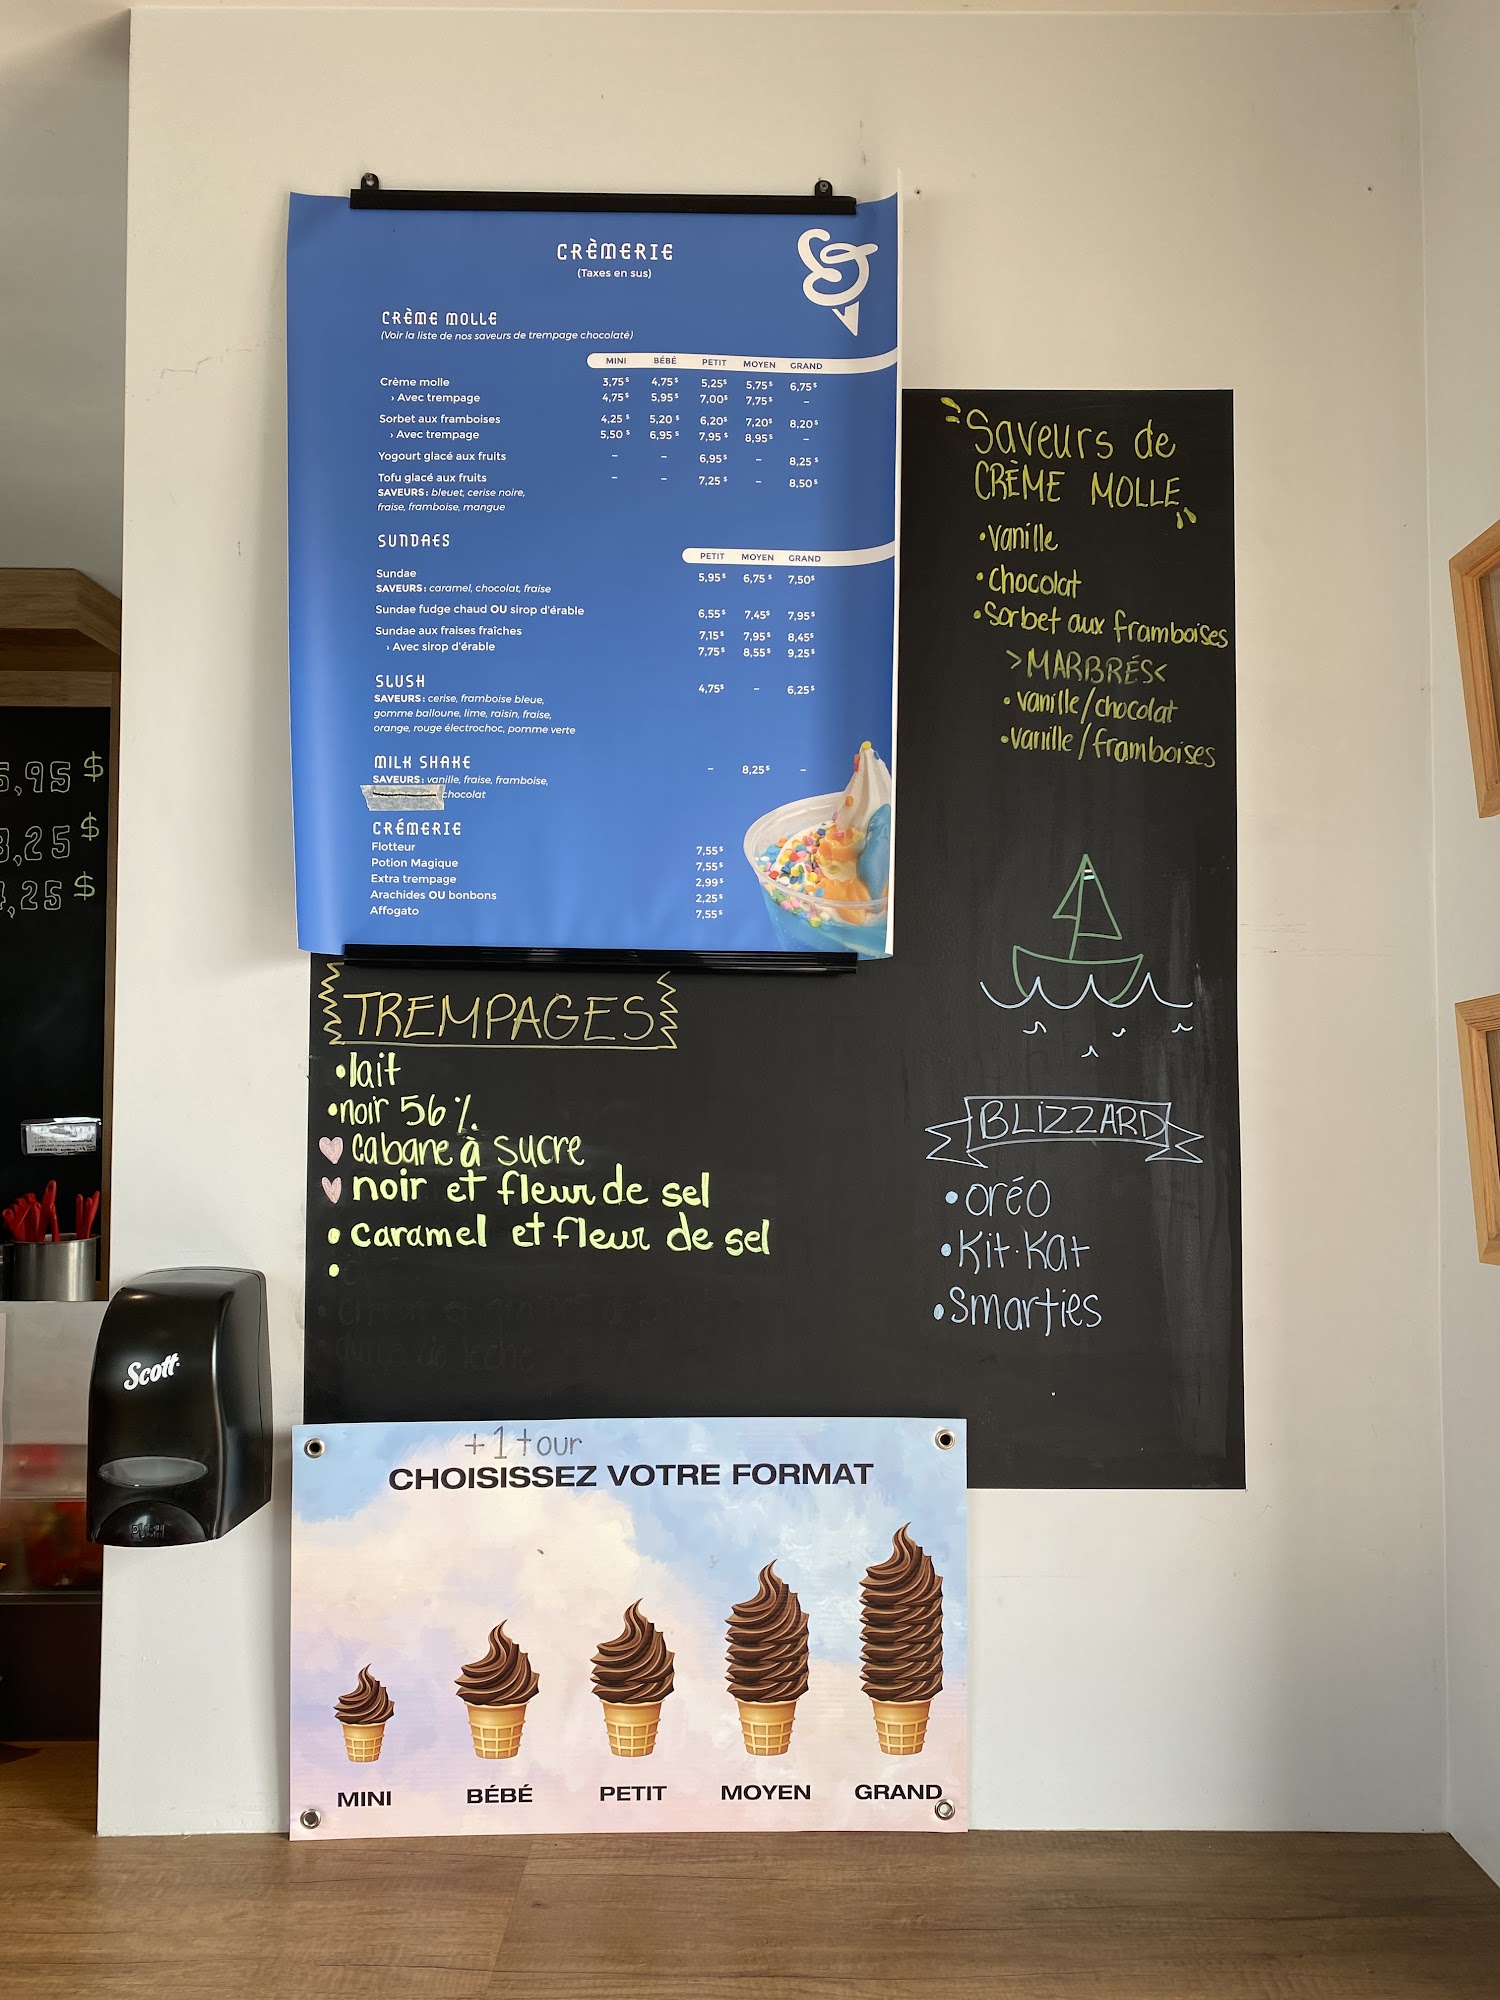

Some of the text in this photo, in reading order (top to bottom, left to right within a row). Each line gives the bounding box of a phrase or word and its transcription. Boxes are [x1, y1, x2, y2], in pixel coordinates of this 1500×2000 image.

[557, 238, 672, 260] CRÈMERIE
[577, 268, 651, 279] (Taxes en sus)
[382, 308, 497, 325] CRÈME MOLLE
[381, 331, 403, 340] (Voir
[405, 331, 415, 339] la
[417, 331, 437, 340] liste
[440, 332, 452, 340] de
[513, 331, 526, 339] de
[529, 332, 578, 341] trempage
[580, 331, 633, 340] chocolaté)
[654, 356, 676, 364] BÉBÉ
[743, 360, 776, 368] MOYEN
[790, 362, 823, 370] GRAND
[380, 377, 450, 386] Crème molle
[397, 393, 480, 404] Avec trempage
[379, 414, 415, 423] Sorbet
[441, 414, 500, 424] framboises
[396, 430, 479, 441] Avec trempage
[966, 409, 1176, 459] Saveurs de
[378, 452, 421, 462] Yogourt
[424, 451, 453, 462] glacé
[478, 451, 506, 461] fruits
[378, 473, 401, 482] Tofu
[404, 473, 433, 484] glacé
[459, 473, 487, 482] fruits
[431, 488, 464, 497] bleuet,
[498, 488, 525, 497] noire,
[1091, 472, 1180, 508] MOLLE
[378, 502, 505, 513] fraise, framboise, mangue
[378, 534, 449, 547] SUNDAES
[700, 552, 724, 560] PETIT
[742, 553, 774, 561] MOYEN
[376, 569, 416, 578] Sundae
[429, 584, 472, 593] caramel,
[475, 584, 521, 593] chocolat,
[524, 584, 551, 593] fraise
[376, 605, 416, 614] Sundae
[419, 604, 451, 616] fudge
[453, 604, 487, 613] chaud
[490, 605, 507, 614] OU
[510, 605, 537, 616] sirop
[375, 626, 416, 635] Sundae
[441, 625, 476, 635] fraises
[479, 626, 522, 635] fraîches
[1068, 614, 1105, 635] aux
[1113, 609, 1228, 648] framboises
[392, 642, 419, 651] Avec
[422, 642, 449, 653] sirop
[376, 674, 424, 688] SLUSH
[428, 694, 458, 703] cerise,
[461, 694, 512, 703] framboise
[514, 695, 544, 705] bleue,
[373, 709, 551, 719] gomme balloune, lime, raisin, fraise,
[373, 725, 410, 734] orange,
[413, 725, 442, 734] rouge
[444, 723, 505, 733] électrochoc,
[507, 726, 548, 734] pomme
[374, 755, 470, 769] MILK SHAKE
[427, 775, 461, 784] vanille,
[464, 775, 492, 784] fraise,
[496, 775, 548, 786] framboise,
[441, 789, 486, 799] chocolat
[373, 818, 461, 835] CRÉMERIE
[372, 842, 415, 851] Flotteur
[372, 858, 458, 869] Potion Magique
[371, 874, 456, 886] Extra trempage
[370, 890, 497, 900] Arachides OU bonbons
[370, 906, 419, 917] Affogato
[343, 991, 654, 1041] TREMPAGES
[350, 1052, 401, 1088] lait
[340, 1096, 389, 1125] noir
[352, 1132, 585, 1168] cabane à sucre
[353, 1163, 709, 1208] noir et fleur de sel
[351, 1211, 770, 1256] caramel et fleur de sel
[123, 1352, 180, 1391] Scott
[389, 1463, 874, 1490] CHOISISSEZ VOTRE FORMAT
[338, 1784, 943, 1807] MINI BÉBÉ PETIT MOYEN GRAND
